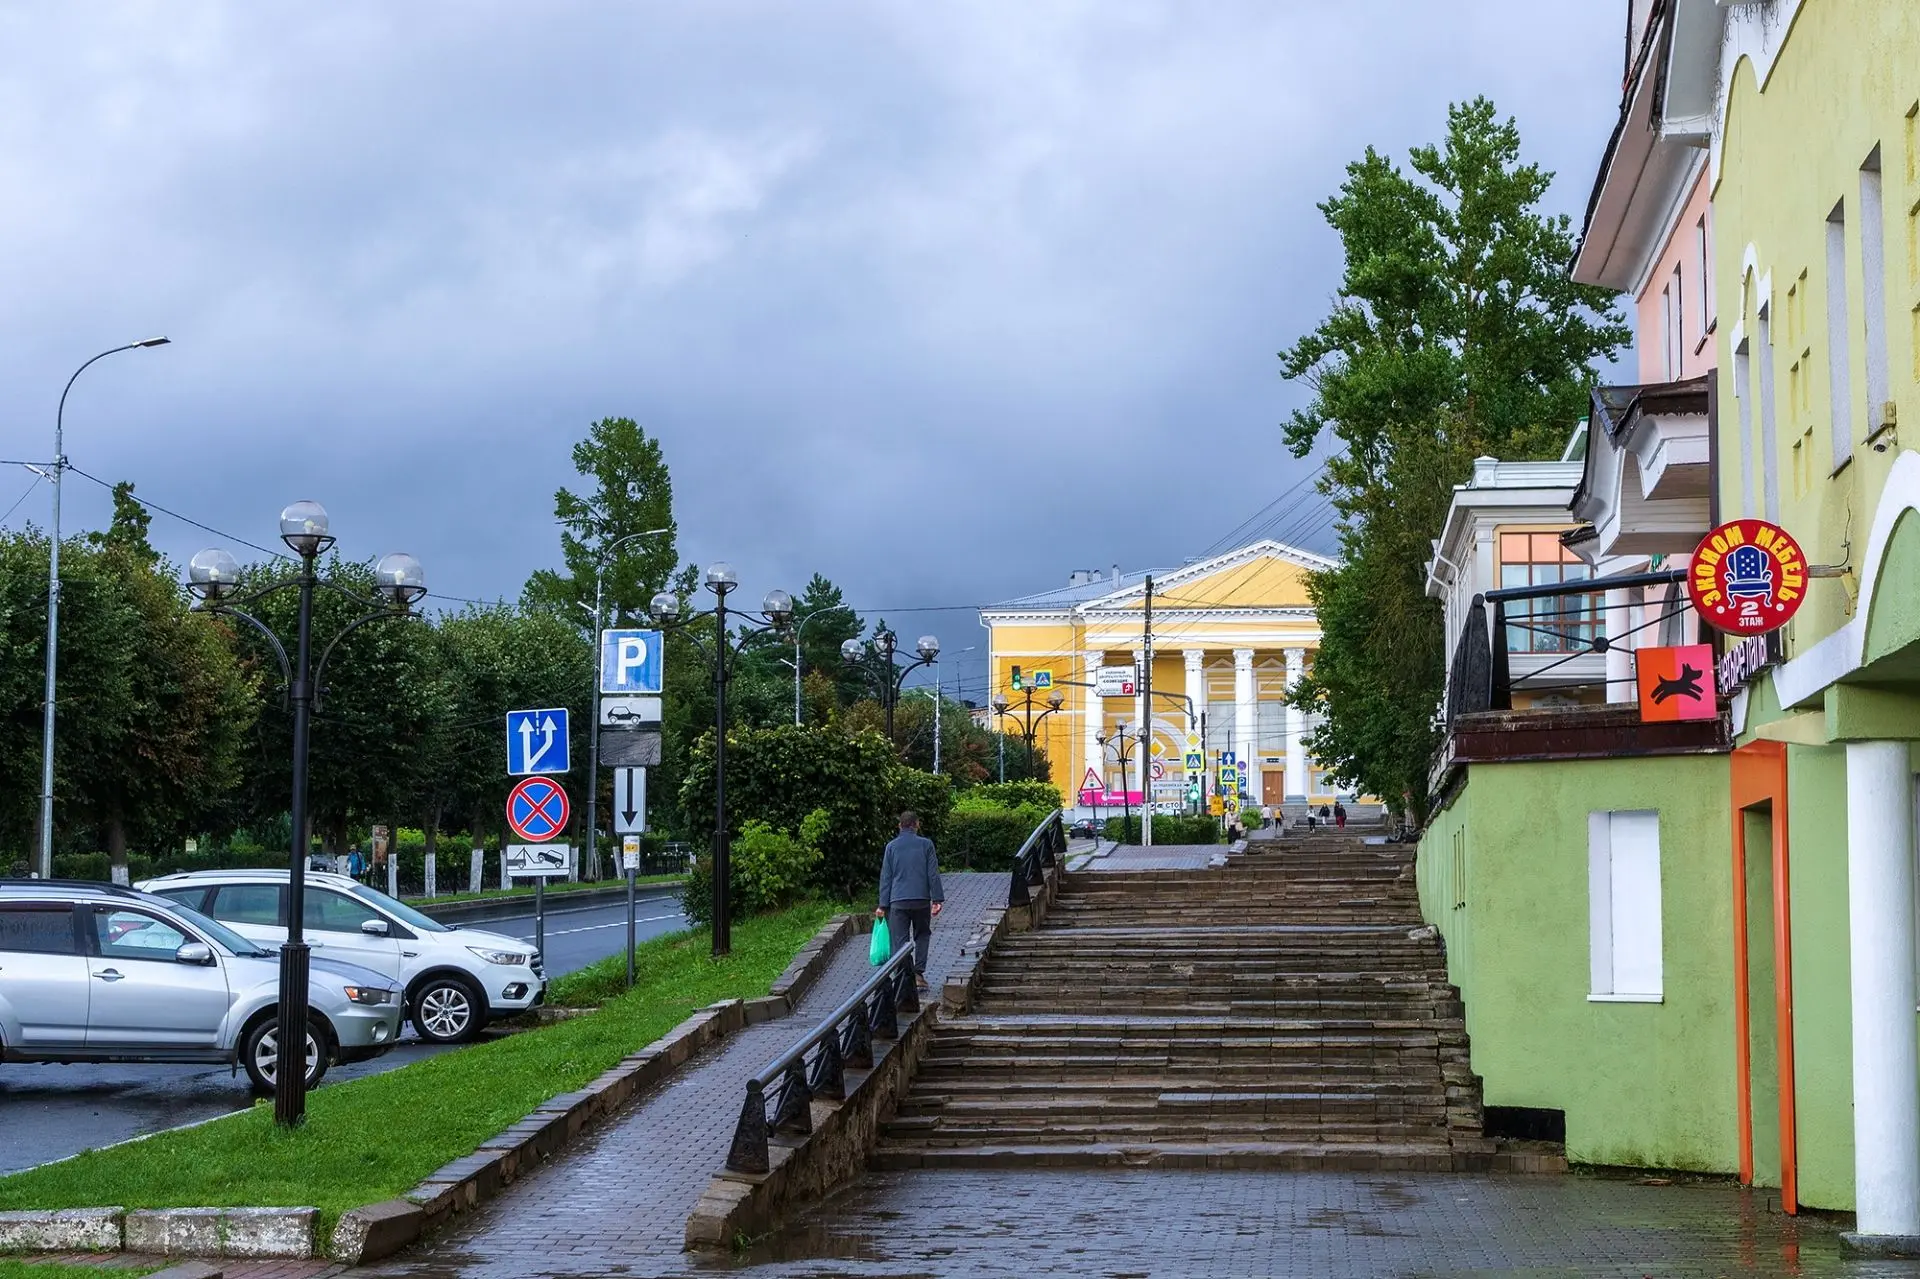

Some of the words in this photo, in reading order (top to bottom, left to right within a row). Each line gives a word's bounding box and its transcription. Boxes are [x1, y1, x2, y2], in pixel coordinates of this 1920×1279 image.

[1695, 525, 1744, 607] ЭКОНОМ
[1754, 526, 1802, 601] МЕБЕЛЬ
[1738, 616, 1764, 627] ЭТАЖ
[1741, 601, 1759, 616] 2
[617, 637, 647, 685] P
